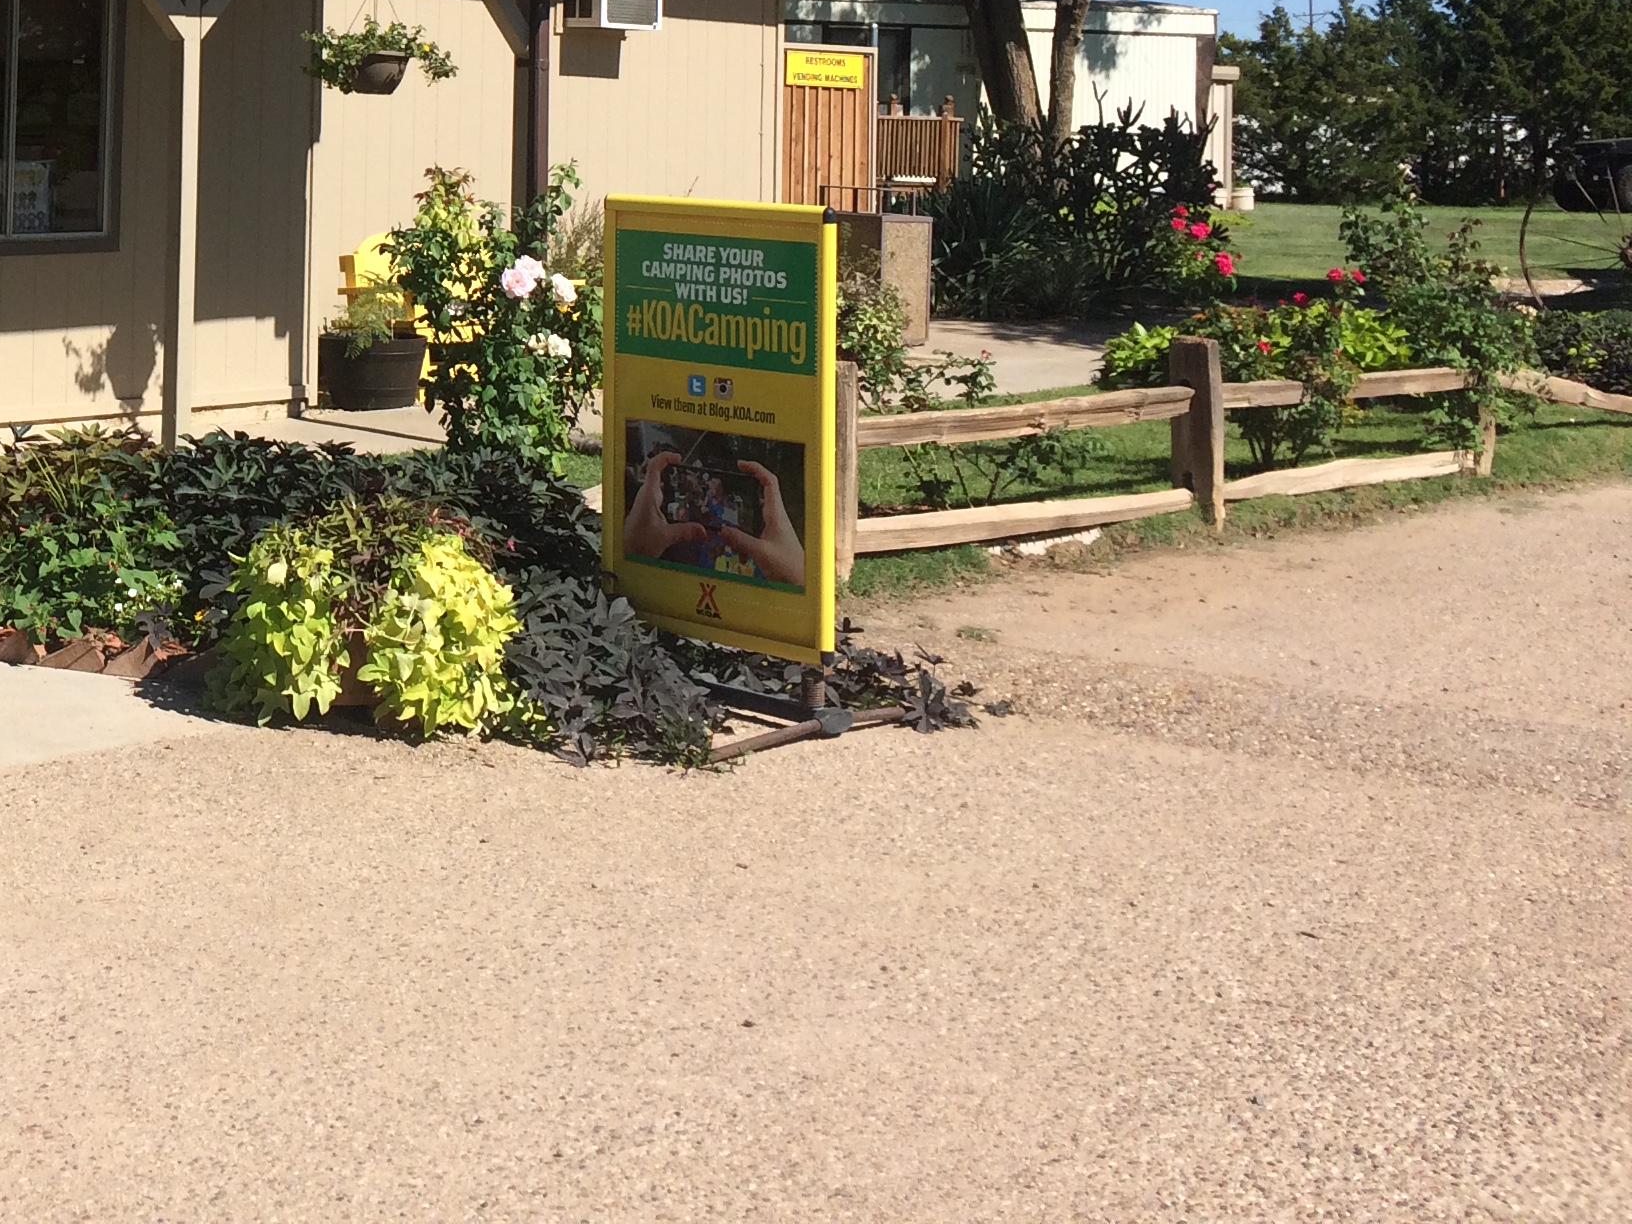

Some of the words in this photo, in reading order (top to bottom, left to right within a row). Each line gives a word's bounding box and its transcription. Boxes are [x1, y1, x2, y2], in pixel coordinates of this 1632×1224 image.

[805, 56, 846, 67] RESTROOMS
[793, 72, 822, 82] VENDING
[824, 74, 858, 84] MACHINES
[662, 242, 716, 263] SHARE
[719, 247, 764, 268] YOUR
[641, 260, 715, 283] CAMPING
[719, 267, 787, 289] PHOTOS
[674, 282, 717, 303] WITH
[720, 287, 748, 306] US!
[626, 298, 808, 365] #KOACamping
[651, 394, 672, 411] View
[674, 397, 696, 414] them
[697, 401, 708, 416] at
[709, 402, 776, 424] Blog.KOA.com
[696, 608, 722, 620] KOA
